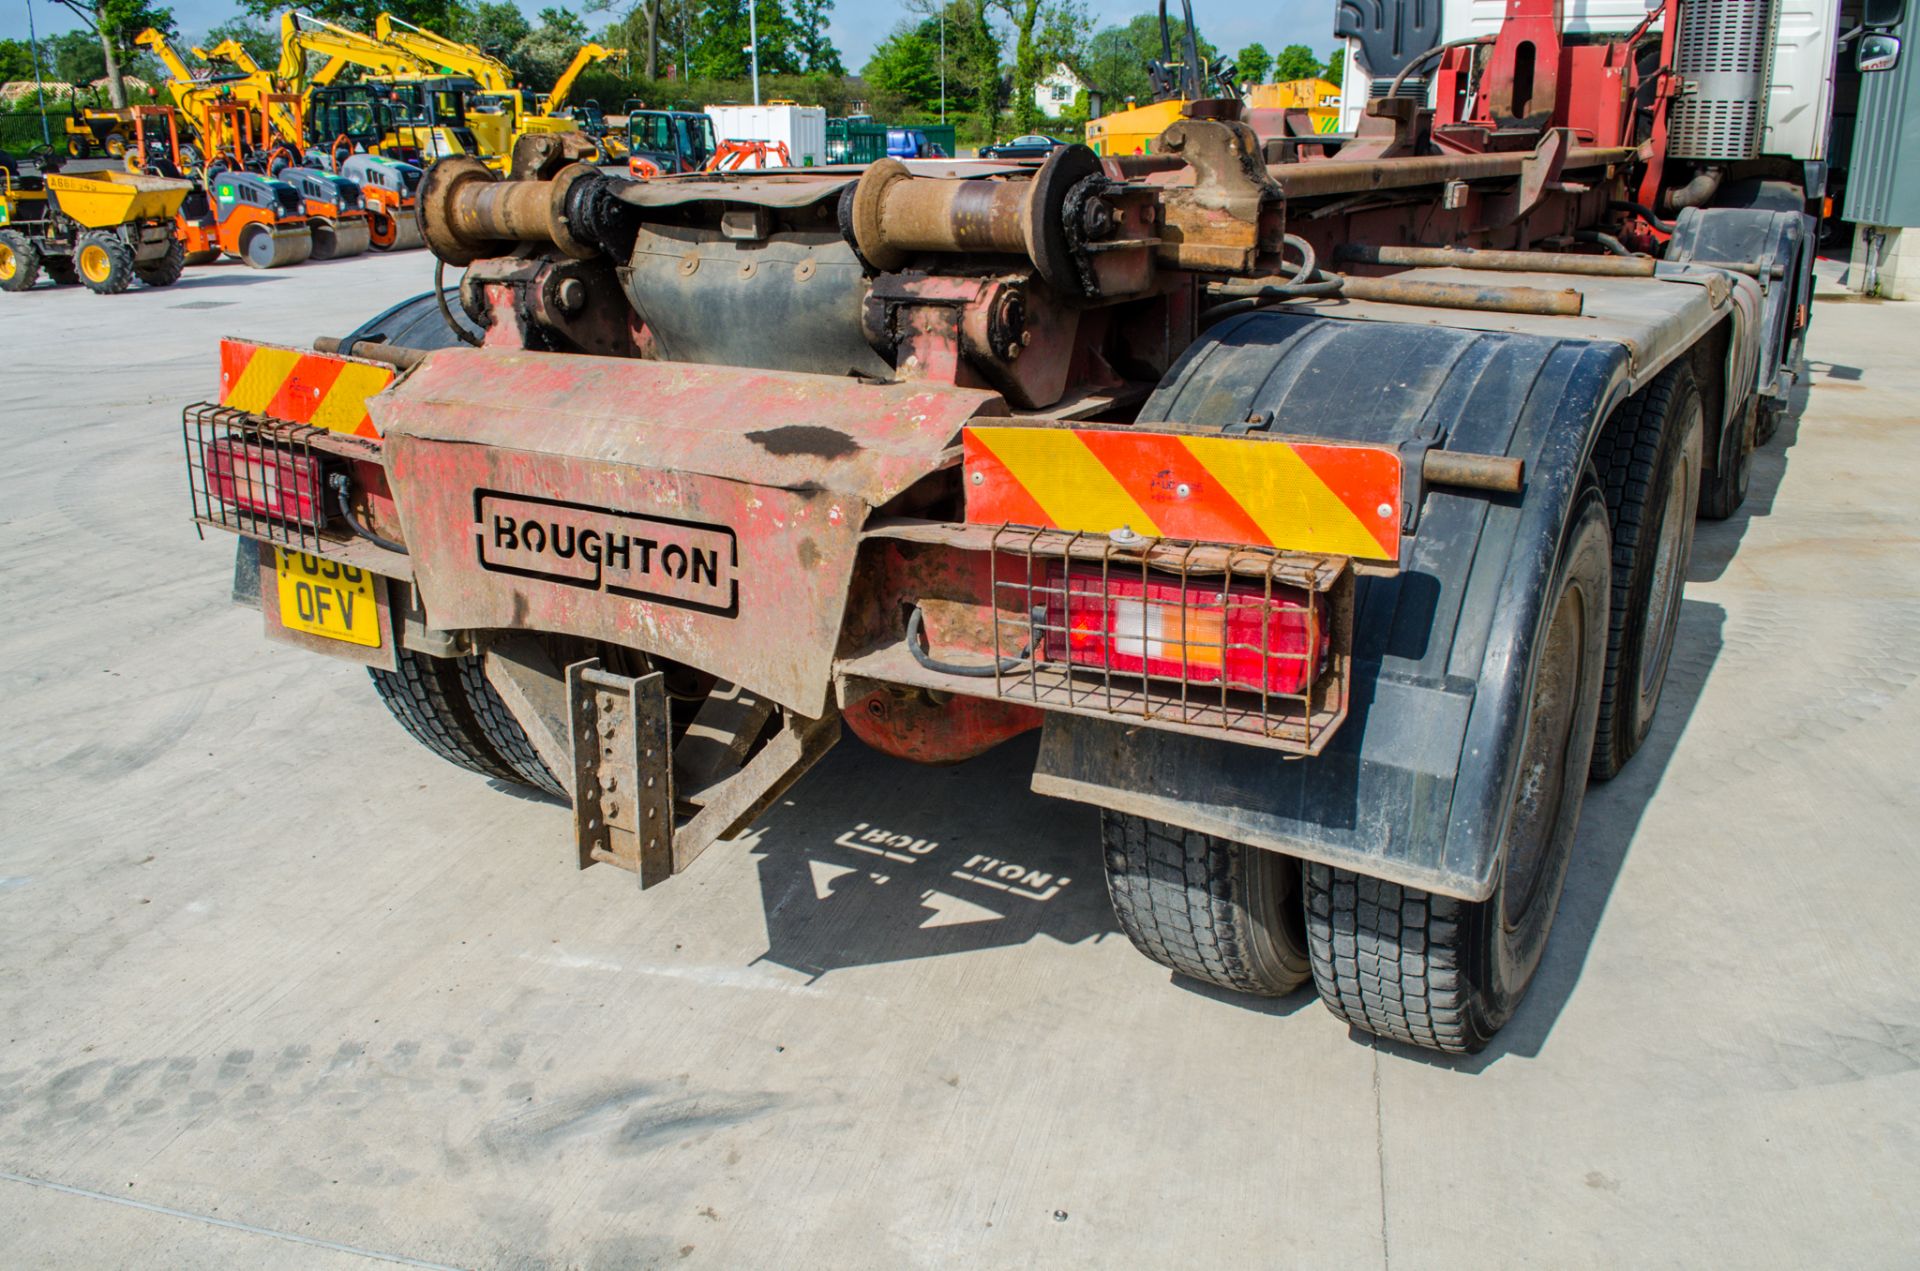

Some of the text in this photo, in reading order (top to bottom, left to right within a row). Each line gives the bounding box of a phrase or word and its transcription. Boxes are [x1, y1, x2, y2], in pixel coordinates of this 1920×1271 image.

[1319, 95, 1342, 108] JC
[494, 515, 718, 587] BOUGHTON
[296, 581, 354, 630] OFV
